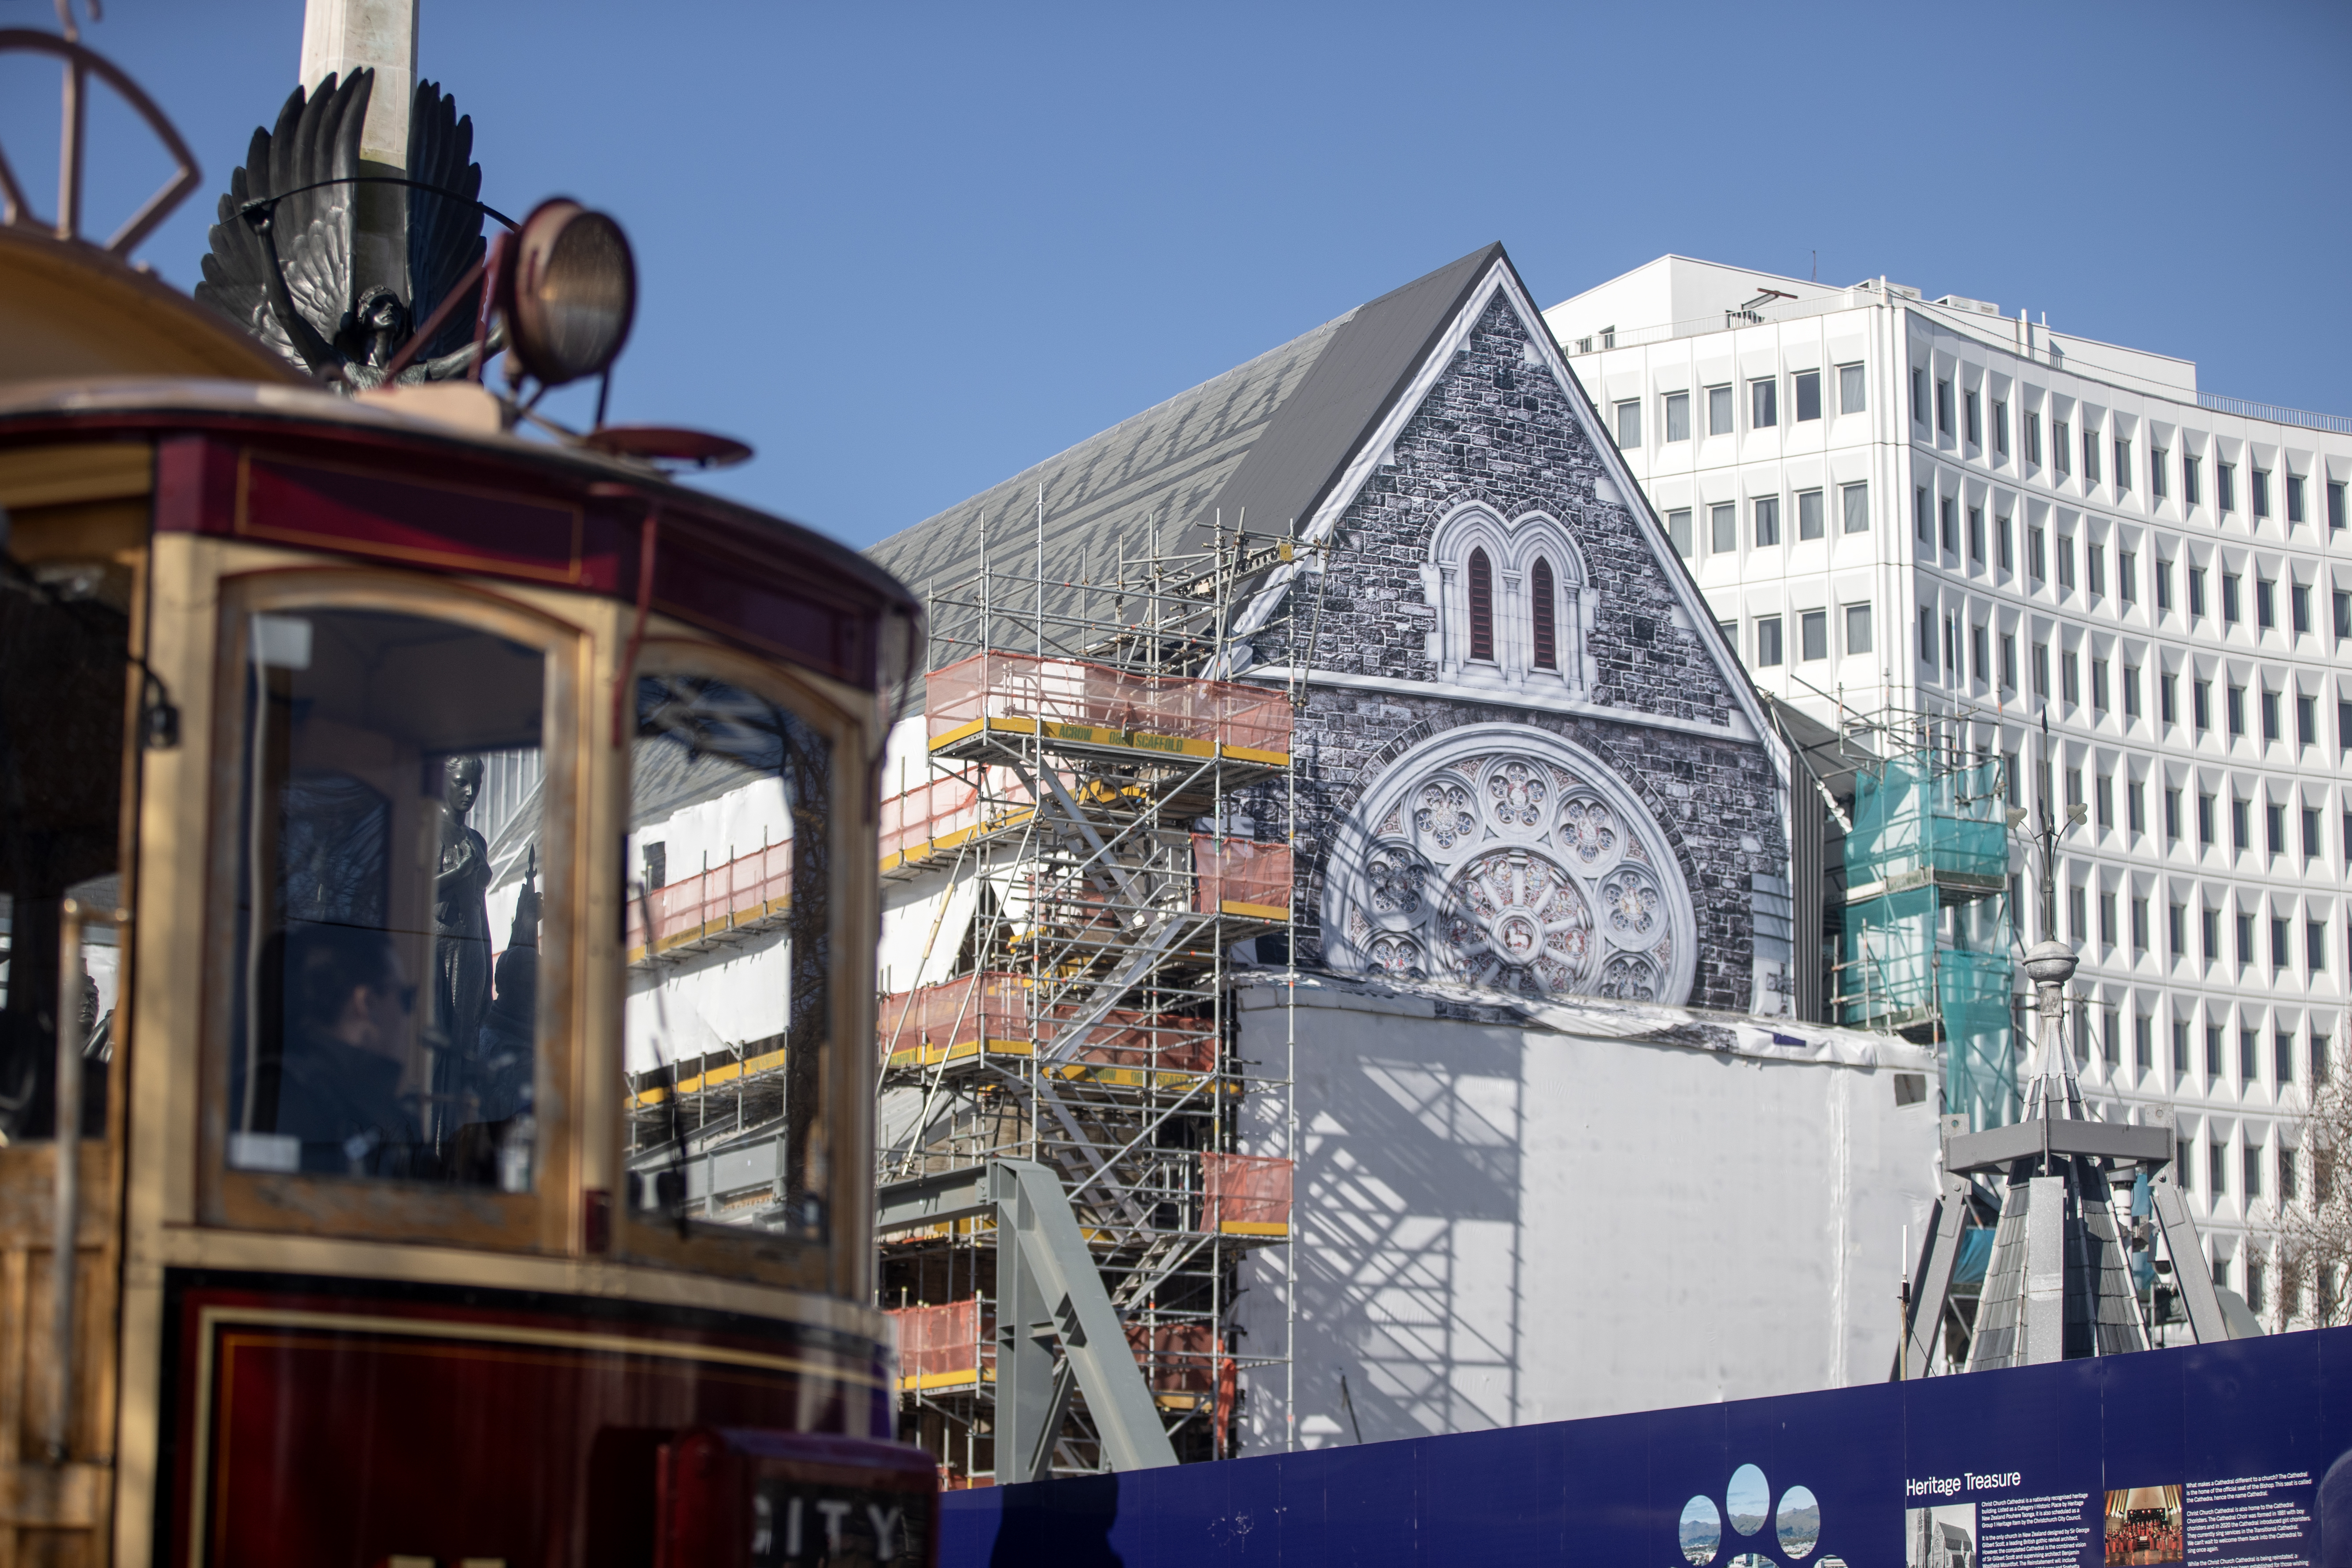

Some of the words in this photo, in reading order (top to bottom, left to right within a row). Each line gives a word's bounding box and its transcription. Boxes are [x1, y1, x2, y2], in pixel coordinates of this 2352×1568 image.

[1059, 725, 1093, 741] ACROW
[1135, 734, 1183, 752] SCAFFOLD
[1906, 1476, 1961, 1496] Heritage
[1964, 1472, 2021, 1490] Treasure
